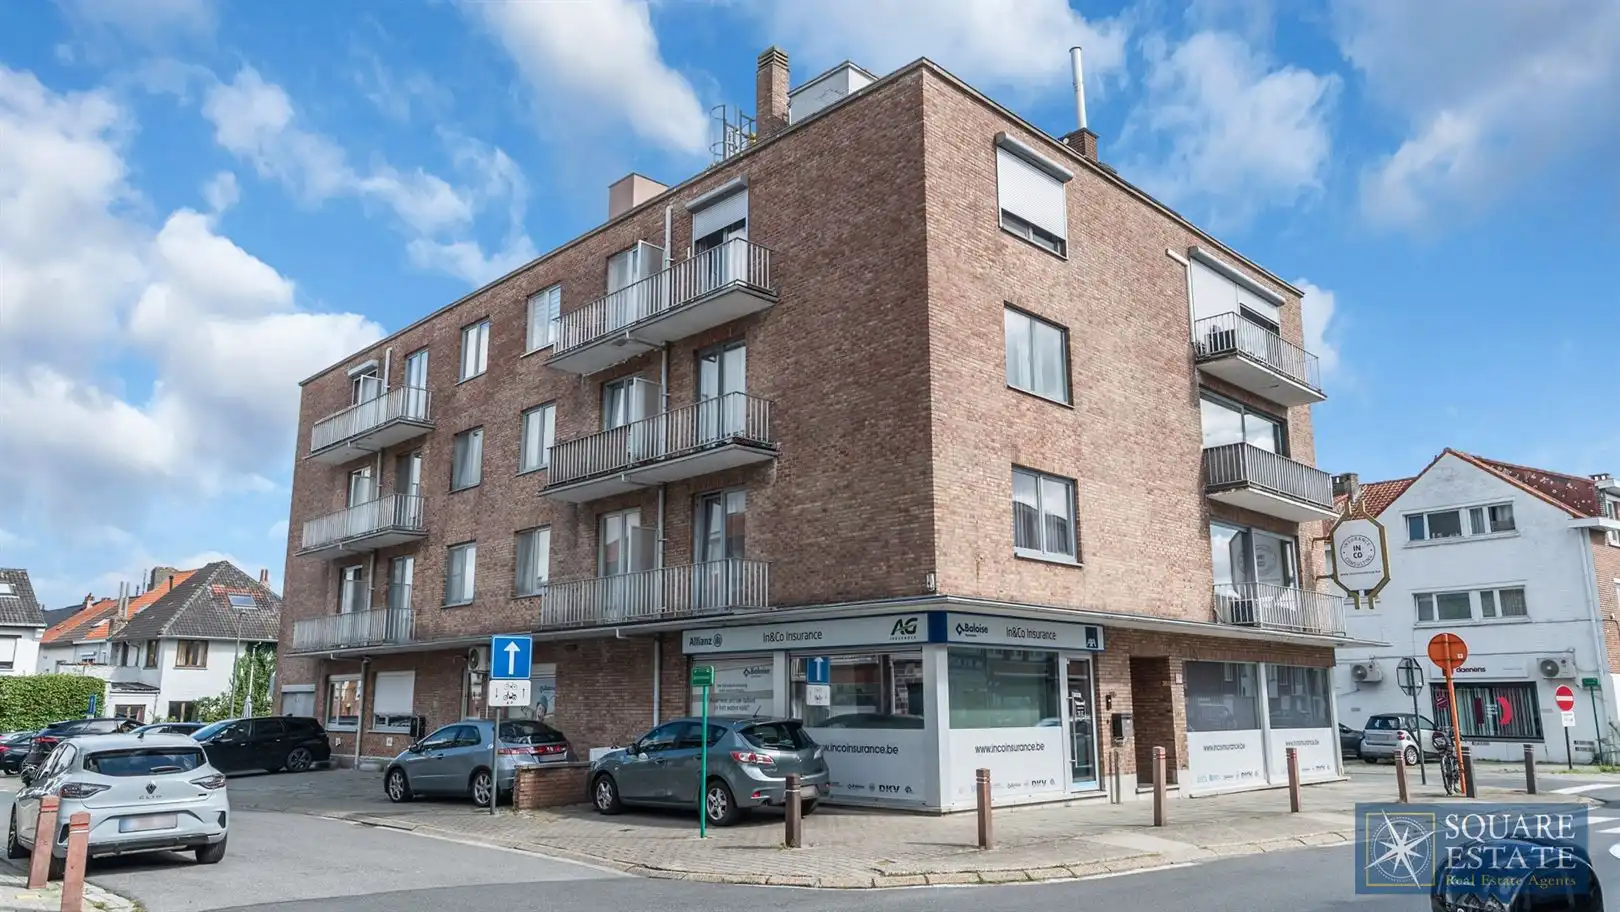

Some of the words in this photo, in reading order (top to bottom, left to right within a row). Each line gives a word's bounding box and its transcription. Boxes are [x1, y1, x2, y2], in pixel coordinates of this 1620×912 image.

[891, 617, 918, 636] AG
[965, 623, 988, 634] Baloise
[763, 632, 784, 643] In&Co
[786, 631, 822, 641] Insurance
[1006, 627, 1025, 638] In&Co
[1027, 628, 1057, 640] Insurance
[689, 636, 712, 646] Allianz
[824, 744, 899, 755] w.incoinsurance.be
[975, 743, 1045, 754] www.incoinsurance.be
[879, 785, 900, 793] DKV
